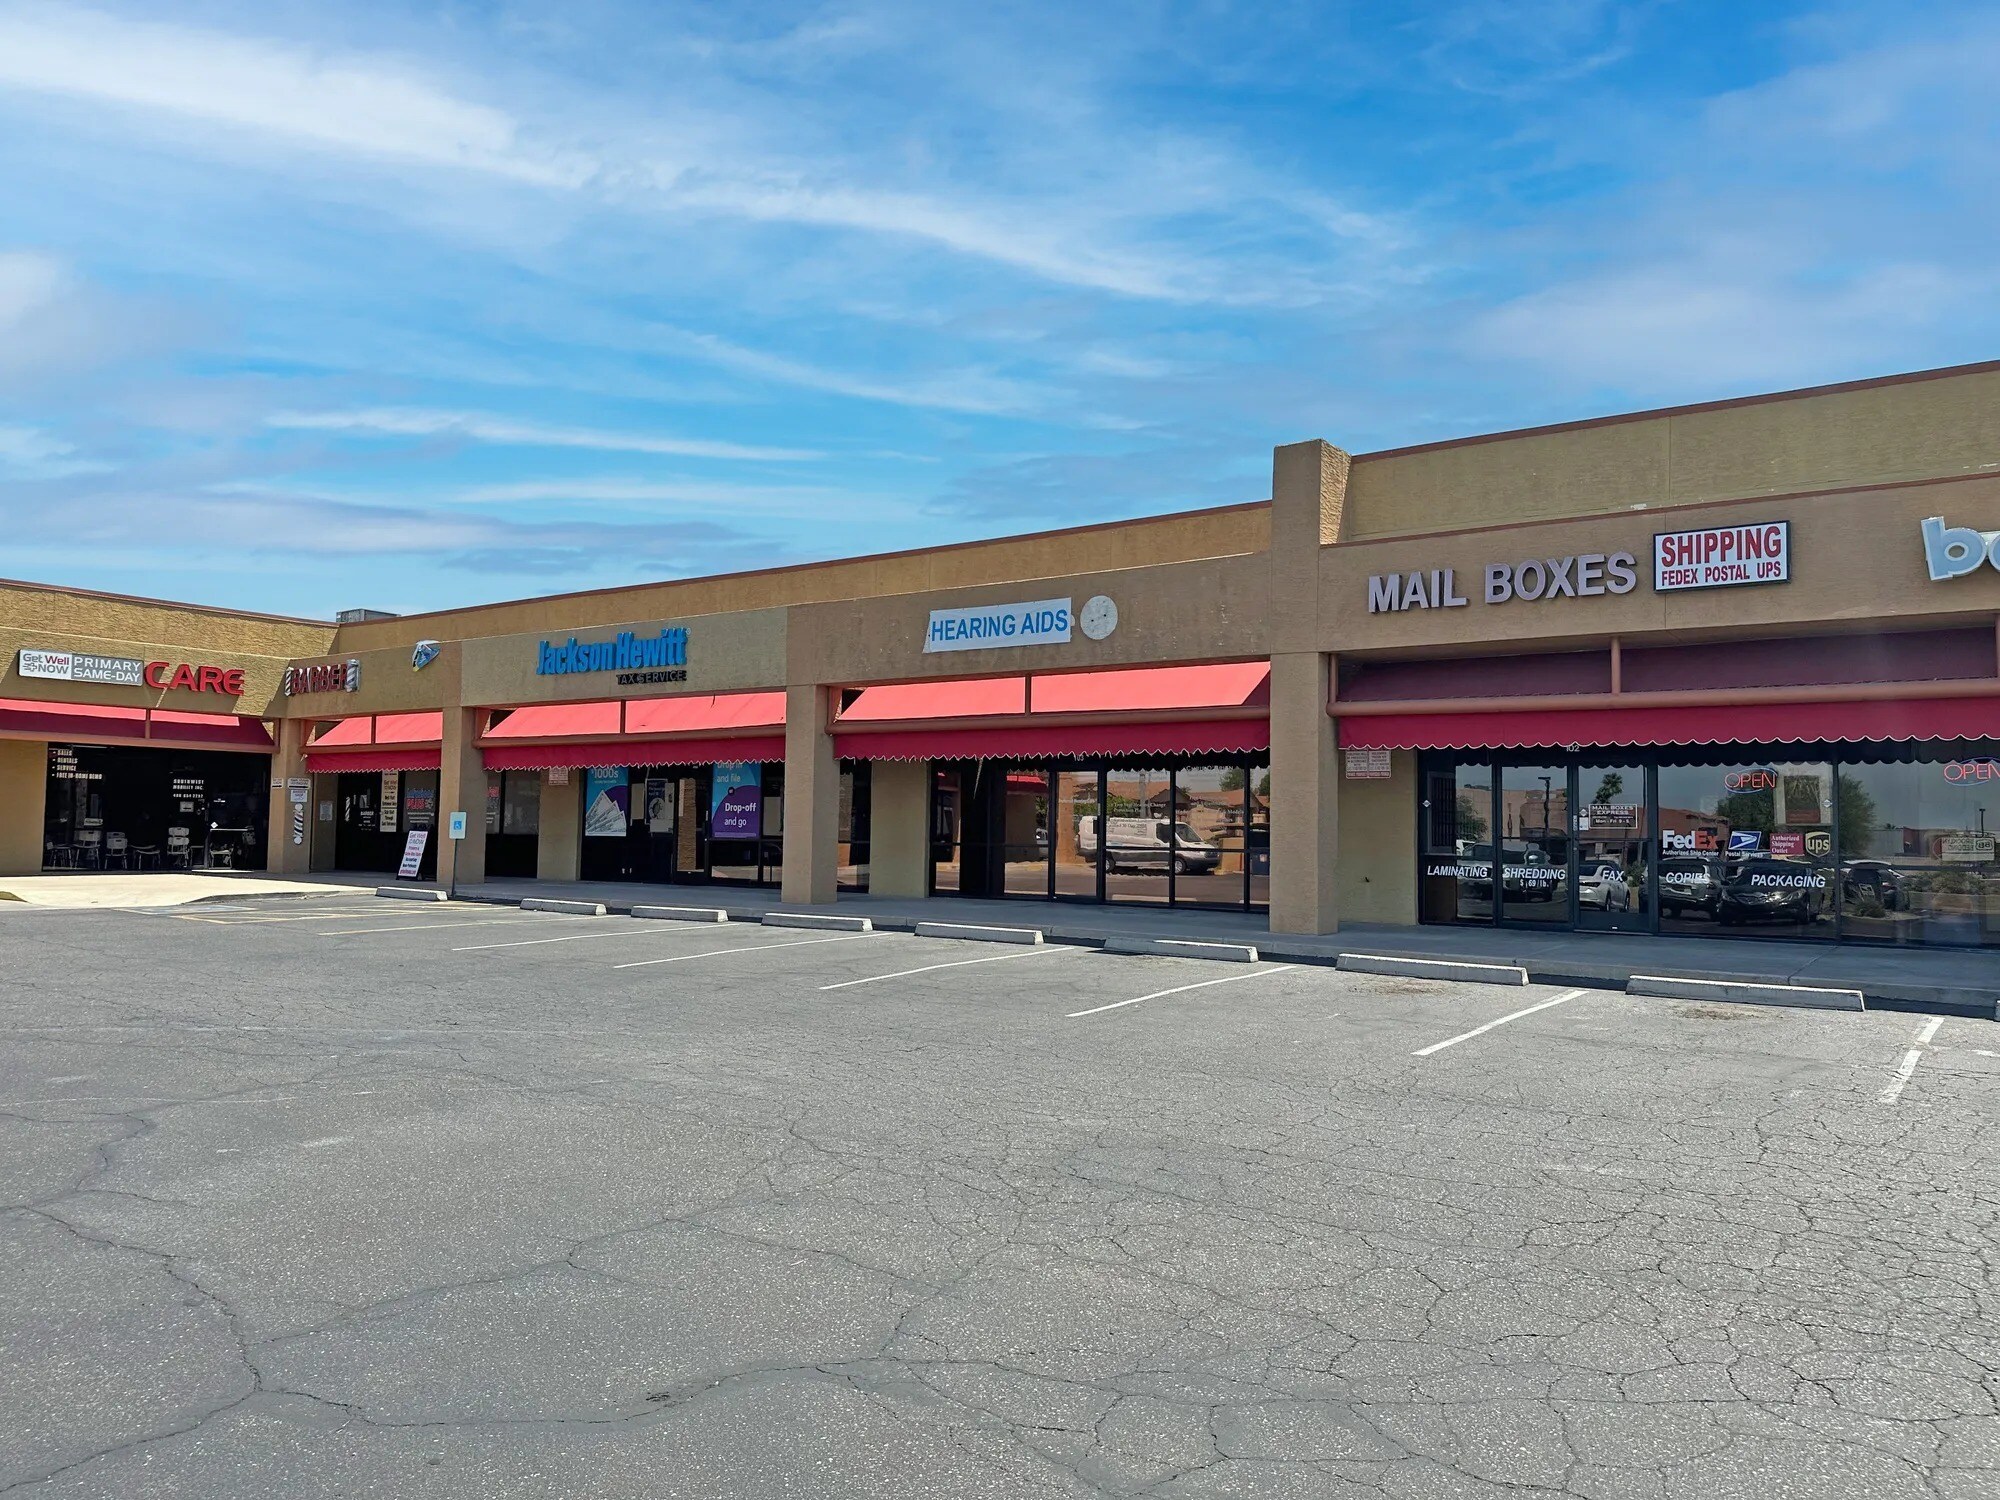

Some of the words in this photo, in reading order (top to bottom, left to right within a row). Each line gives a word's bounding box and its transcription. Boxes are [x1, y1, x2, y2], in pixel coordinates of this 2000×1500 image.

[1661, 526, 1781, 568] SHIPPING
[1921, 516, 2000, 580] b
[1661, 569, 1698, 587] FEDEX
[1705, 563, 1750, 582] POSTAL
[1757, 560, 1781, 579] UPS
[1368, 568, 1467, 613] MAIL
[1485, 552, 1637, 604] BOXES
[932, 614, 1016, 642] HEARING
[1020, 609, 1068, 635] AIDS
[536, 637, 616, 675] Jackson
[615, 627, 688, 669] Hewitt
[23, 653, 43, 664] Get
[45, 655, 70, 666] Well
[74, 656, 141, 672] PRIMARY
[38, 664, 69, 675] NOW
[74, 668, 140, 683] SAME-DAY
[144, 661, 245, 696] CARE
[291, 663, 348, 694] BARBER
[616, 673, 637, 685] TAX
[638, 670, 687, 684] SERVICE
[716, 775, 729, 783] and
[730, 774, 741, 783] file
[1725, 772, 1776, 788] OPEN
[725, 803, 756, 814] Drop-off
[724, 817, 737, 826] and
[738, 818, 747, 828] go
[1662, 830, 1718, 849] FedEx
[1807, 840, 1830, 854] ups
[1427, 865, 1488, 877] LAMINATING
[1503, 867, 1566, 880] SHREDDING
[1602, 870, 1624, 881] FAX
[1666, 872, 1710, 885] COPIES
[1751, 874, 1826, 888] PACKAGING
